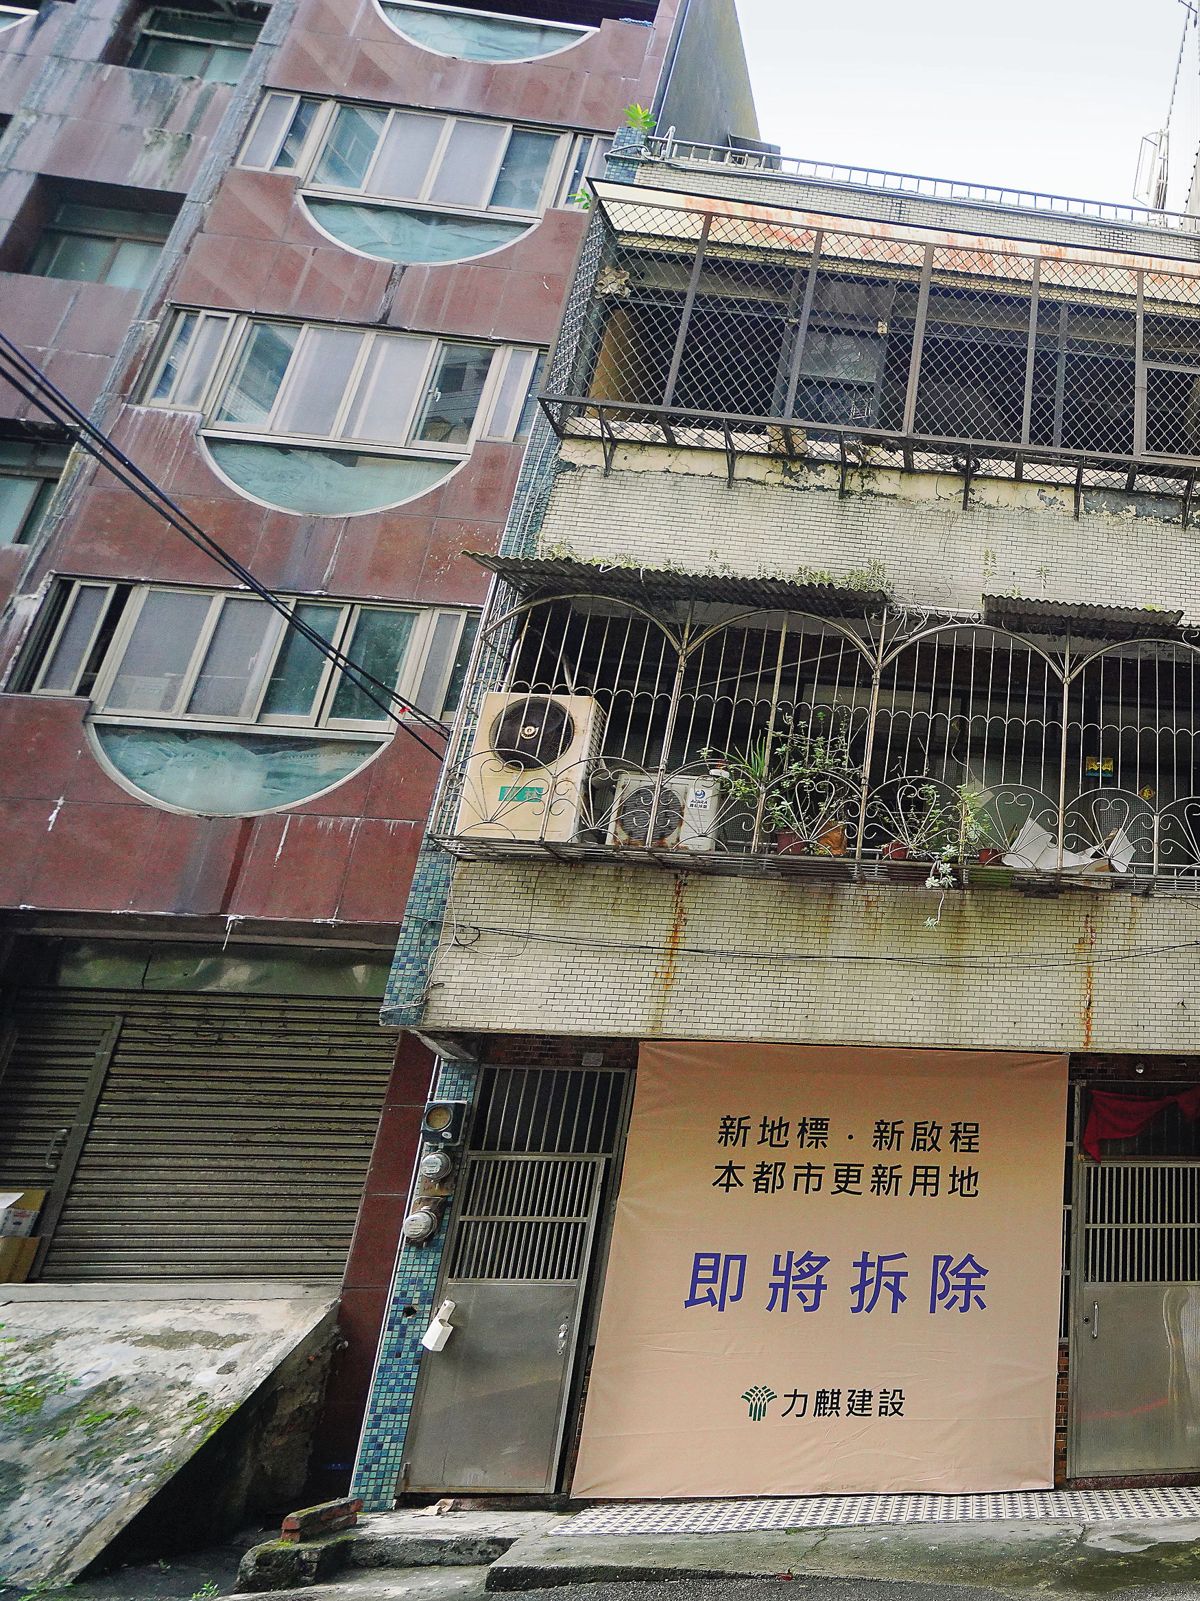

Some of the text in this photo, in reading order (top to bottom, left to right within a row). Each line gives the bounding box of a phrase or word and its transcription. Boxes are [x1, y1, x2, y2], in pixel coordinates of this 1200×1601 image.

[711, 1159, 980, 1199] 本都市更新用地
[683, 1250, 990, 1314] 即將拆除
[781, 1387, 906, 1419] 力麒建設
